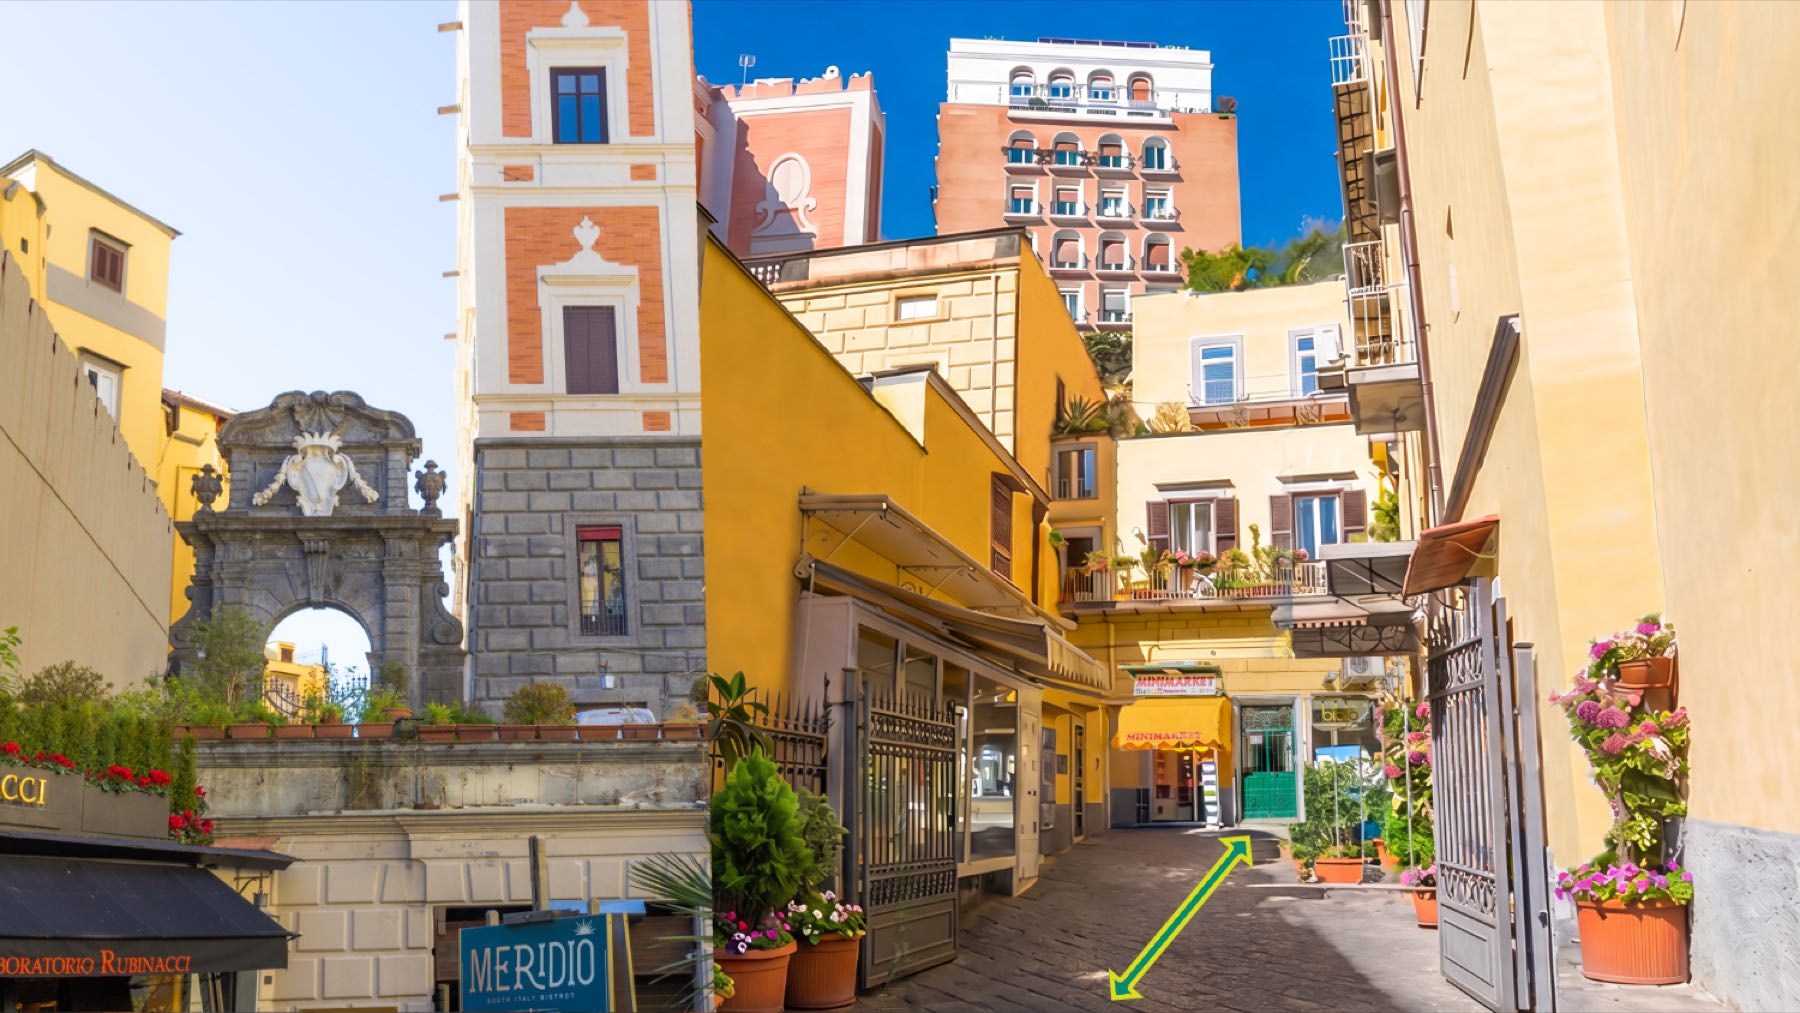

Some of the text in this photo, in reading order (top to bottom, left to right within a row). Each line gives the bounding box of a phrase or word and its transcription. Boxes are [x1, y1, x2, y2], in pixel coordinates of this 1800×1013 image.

[1136, 675, 1215, 687] MINIMARKET
[1126, 731, 1201, 741] MINIMARKET
[0, 774, 47, 804] CCI
[100, 949, 191, 974] RUBINACCI
[469, 938, 596, 993] MERIDIO
[487, 992, 575, 1004] SOUTH ITALY BISTROT
